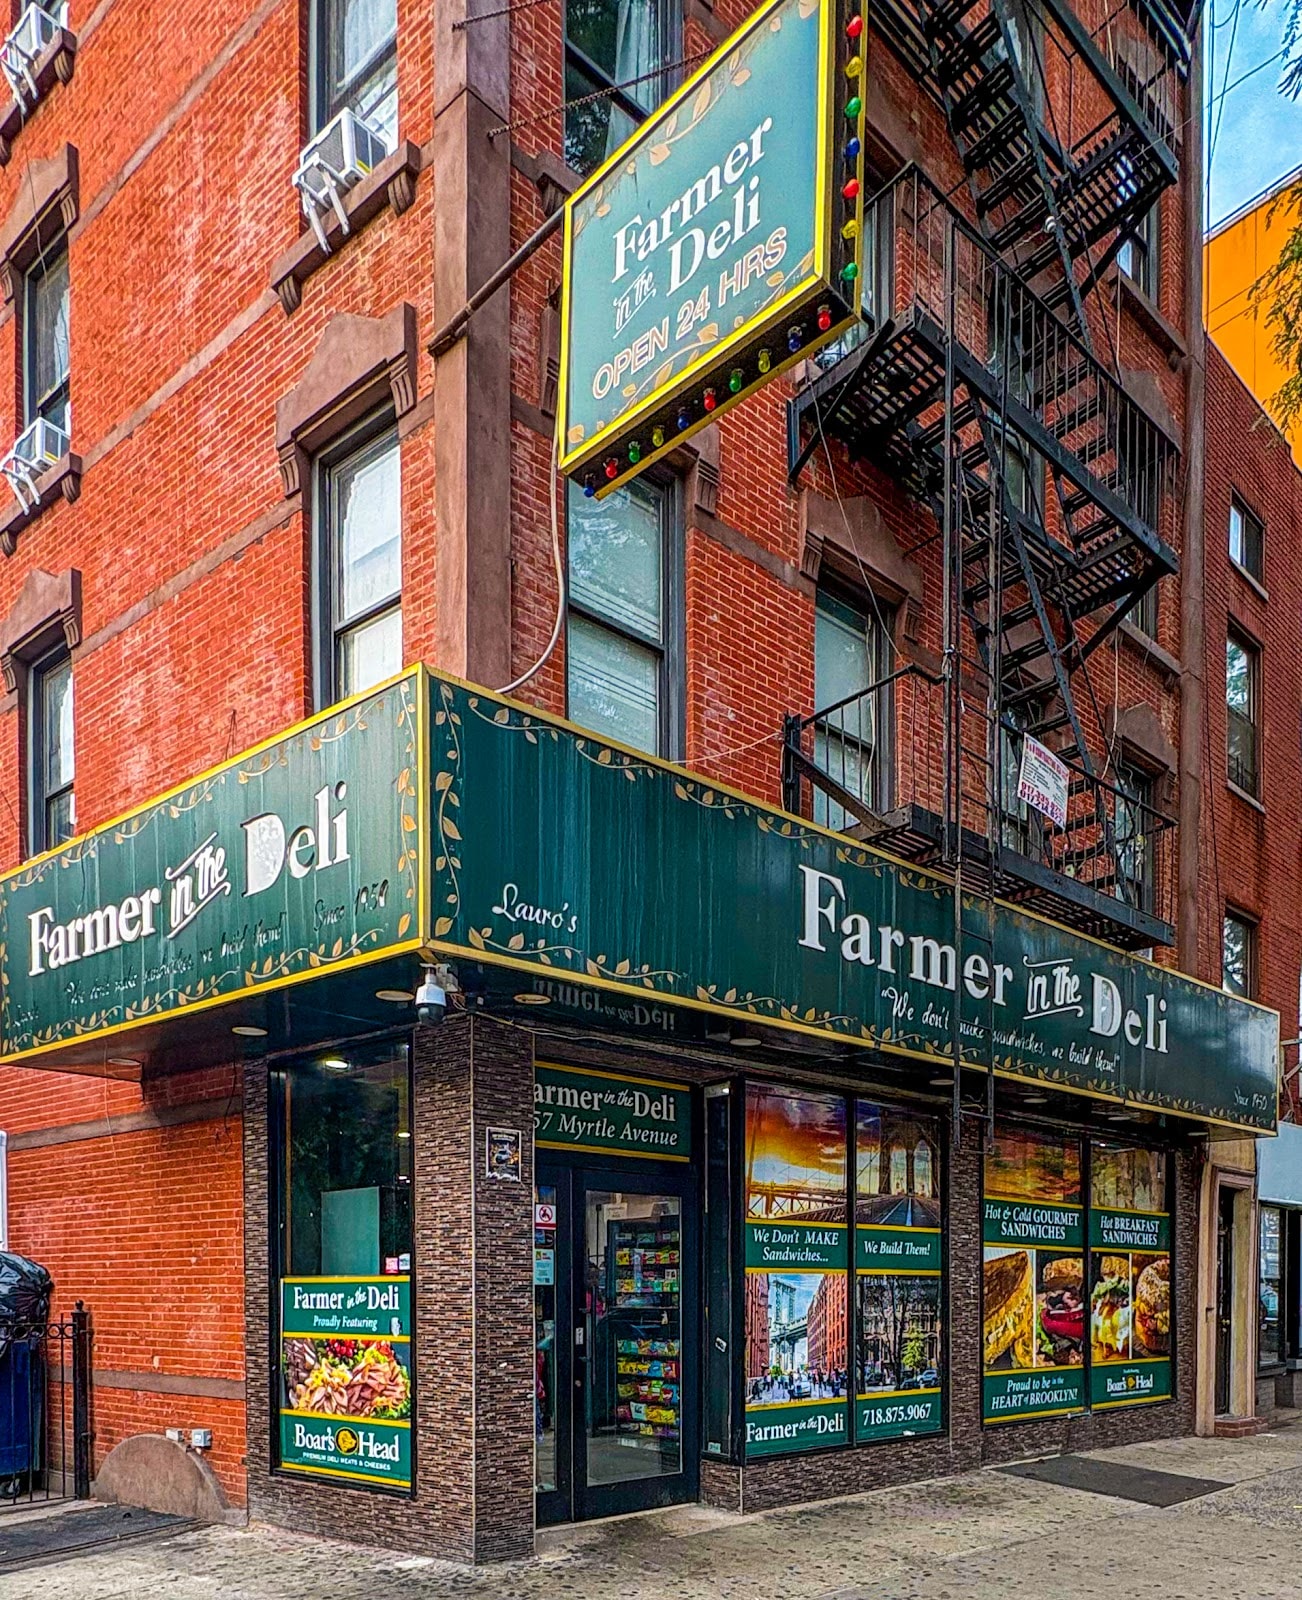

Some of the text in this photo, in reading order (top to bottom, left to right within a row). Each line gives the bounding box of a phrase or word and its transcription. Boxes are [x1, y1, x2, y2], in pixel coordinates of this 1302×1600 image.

[611, 116, 773, 284] Farmer
[666, 175, 762, 298] Deli
[592, 226, 788, 400] OPEN 24 HRS
[27, 886, 162, 977] Farmer
[240, 780, 350, 898] Deli
[798, 863, 1015, 1007] Farmer
[1090, 972, 1169, 1054] Deli
[603, 1089, 616, 1105] in
[617, 1089, 634, 1107] the
[633, 1090, 676, 1122] Deli
[557, 1113, 616, 1140] Myrtle
[619, 1122, 678, 1146] Avenue
[985, 1204, 1079, 1226] Hot & Cold GOURMET
[1100, 1215, 1160, 1233] Hot BREAKFAST
[753, 1228, 839, 1246] We Don't MAKE
[1001, 1221, 1066, 1240] SANDWICHES
[1102, 1231, 1158, 1246] SANDWICHES
[864, 1240, 931, 1257] We Build Them!
[293, 1286, 344, 1310] Farmer
[355, 1286, 367, 1305] the
[367, 1285, 400, 1310] Deli
[313, 1315, 378, 1332] Proudly Featuring
[1007, 1377, 1031, 1393] Proud
[1032, 1379, 1040, 1390] to
[1041, 1376, 1051, 1389] be
[1136, 1373, 1153, 1389] Head
[991, 1394, 1024, 1410] HEART
[1029, 1388, 1078, 1405] BROOKLYN!
[862, 1403, 932, 1426] 718.875.9067
[746, 1418, 799, 1443] Farmer
[818, 1413, 844, 1434] Deli
[294, 1423, 400, 1462] Boar's Head
[327, 1455, 340, 1463] DELI
[340, 1457, 358, 1466] MEATS
